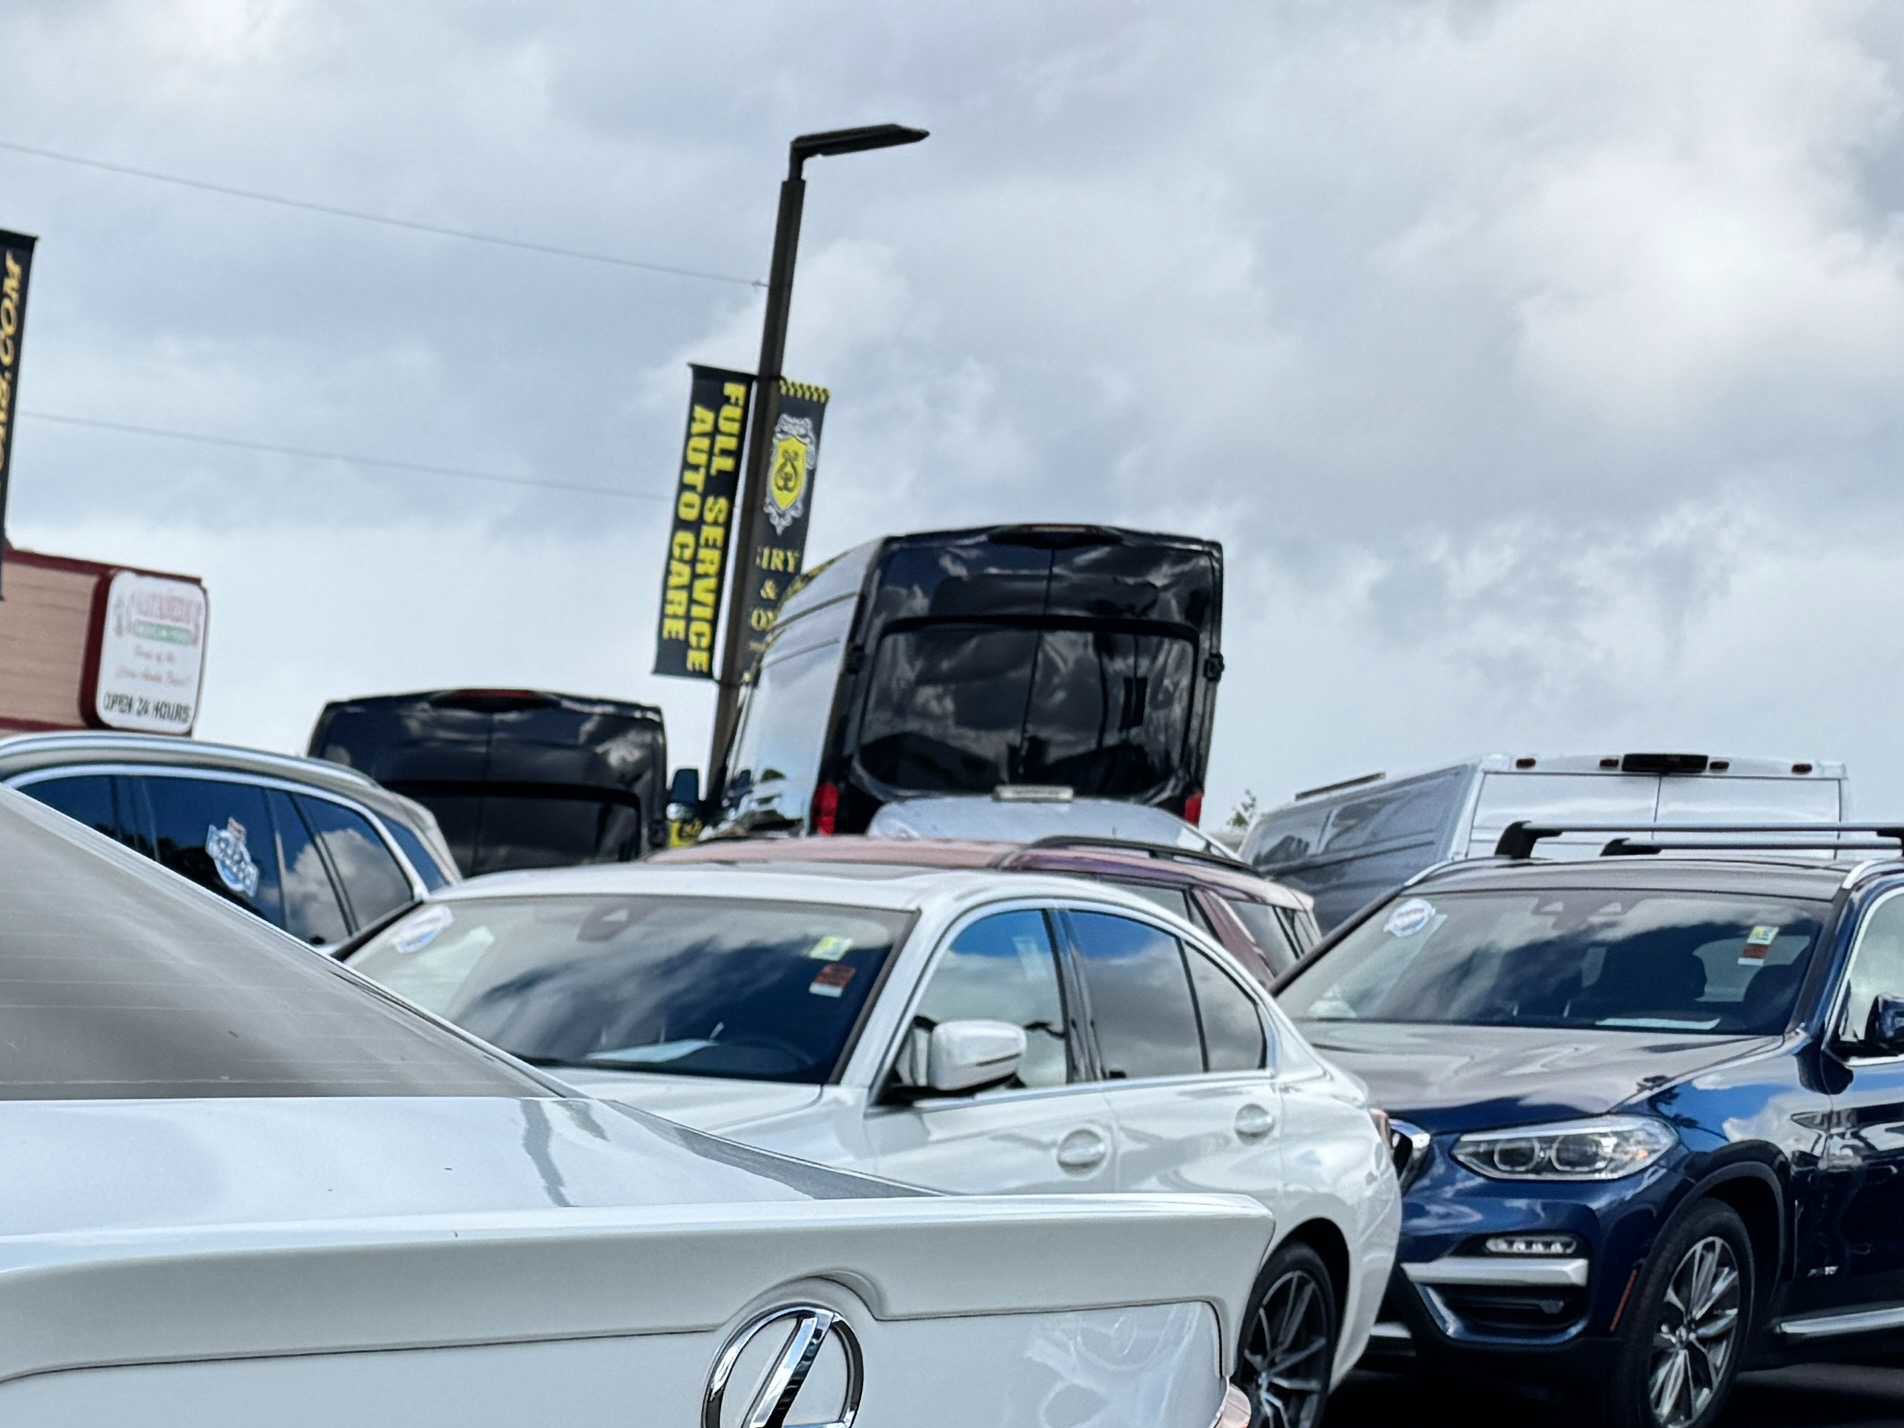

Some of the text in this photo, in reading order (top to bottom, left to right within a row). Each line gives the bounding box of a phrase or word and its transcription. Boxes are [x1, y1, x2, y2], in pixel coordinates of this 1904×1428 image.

[662, 403, 715, 642] AUTO CARE
[686, 381, 747, 674] FULL SERVICE
[103, 691, 133, 714] OPEN
[153, 700, 192, 724] HOURS
